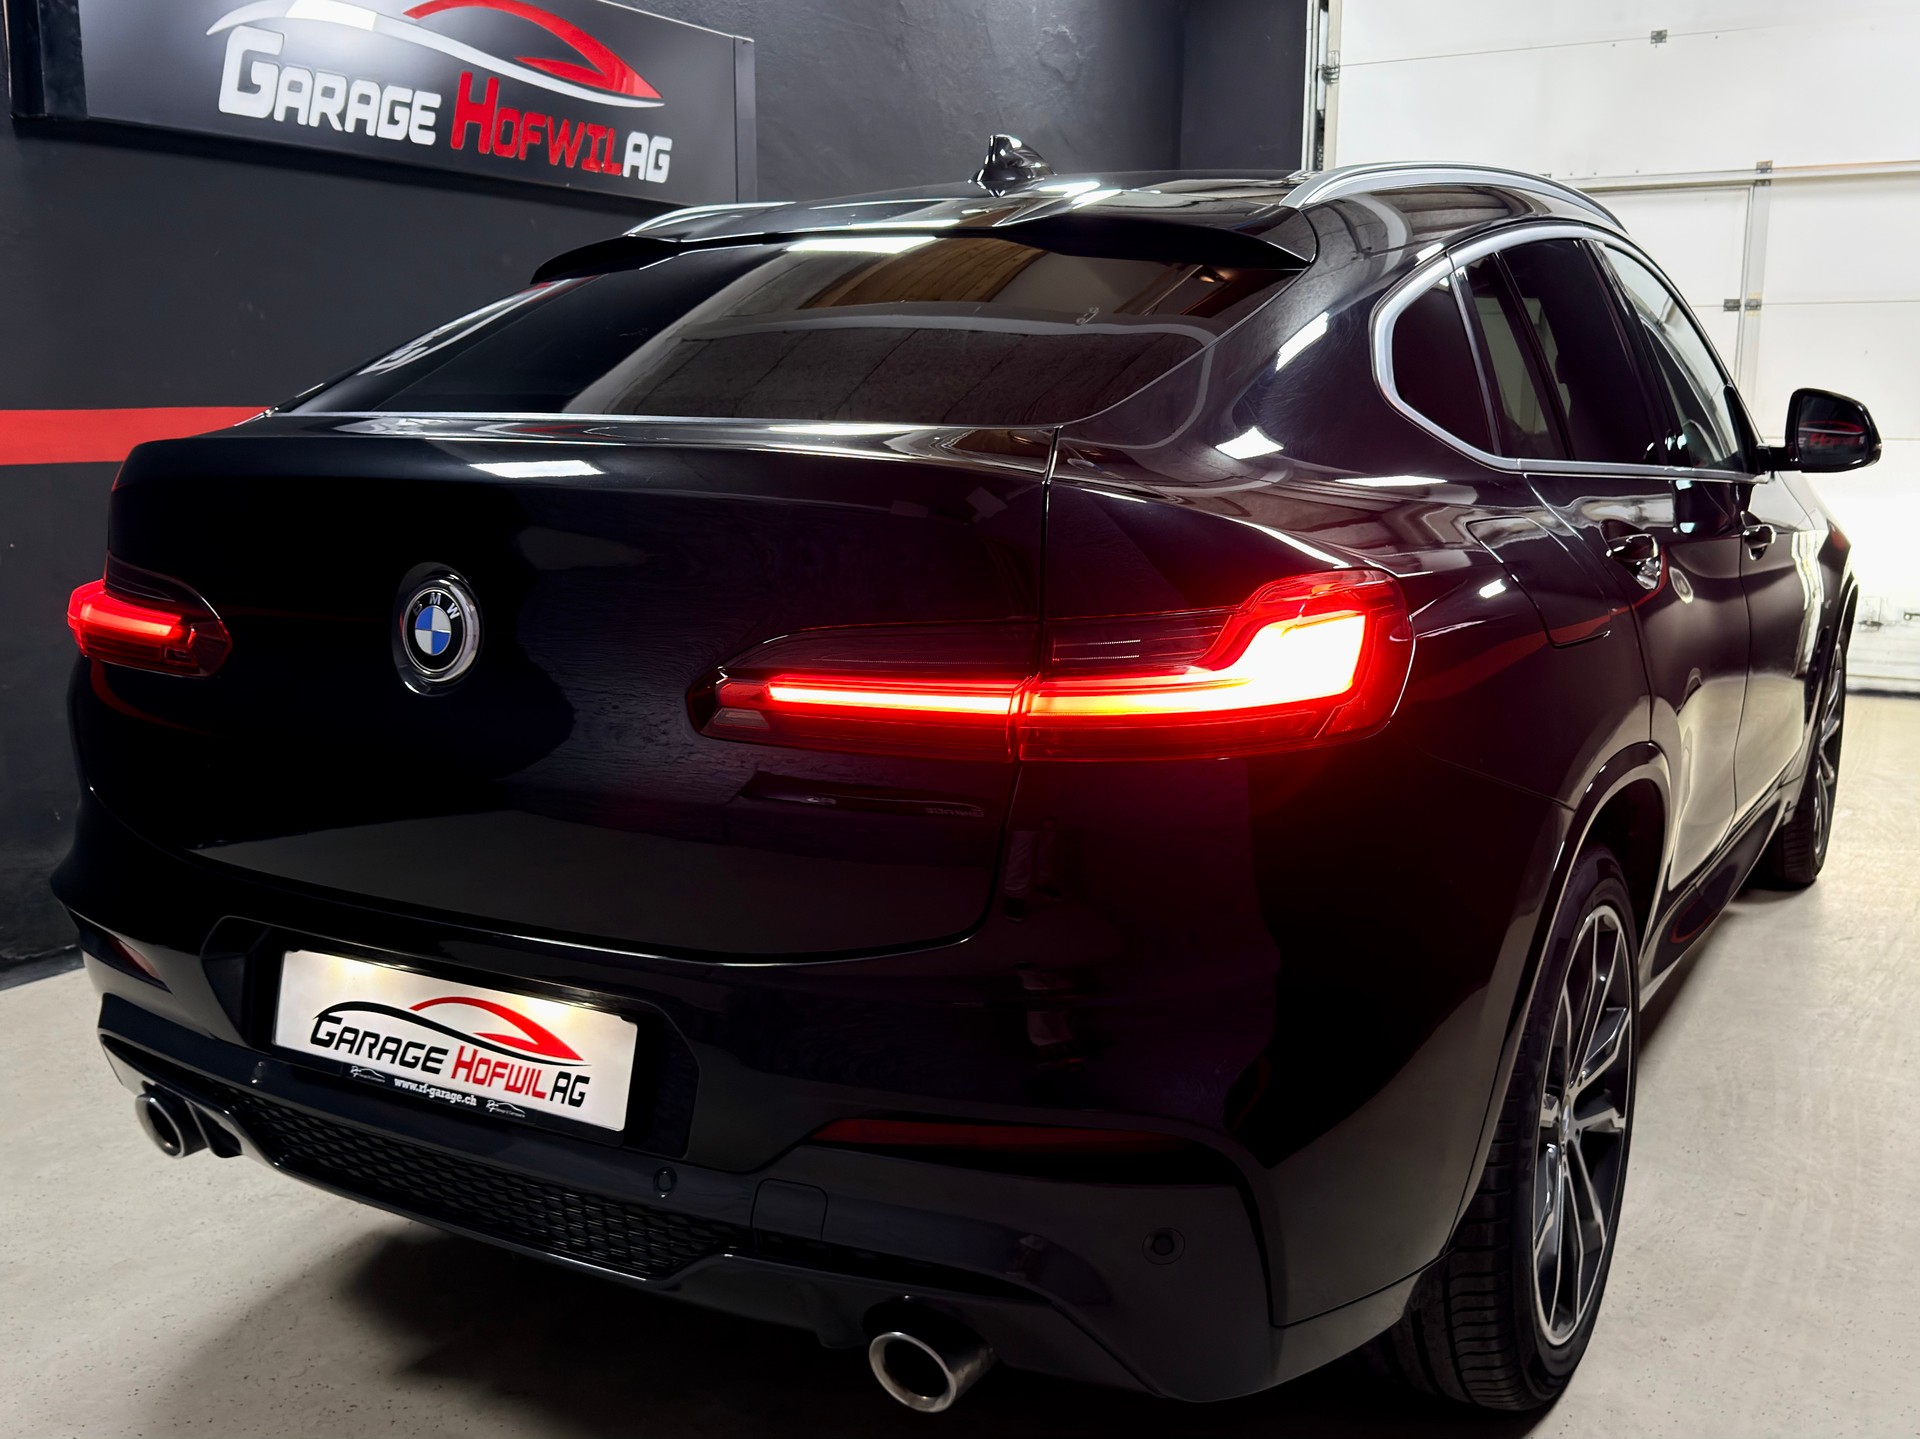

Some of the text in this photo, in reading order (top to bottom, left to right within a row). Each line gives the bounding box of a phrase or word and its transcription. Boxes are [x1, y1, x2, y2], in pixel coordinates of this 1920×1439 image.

[218, 25, 442, 146] GARAGE
[412, 592, 460, 620] BMW
[310, 1015, 591, 1108] GARAGE HOFWIL AG
[394, 1078, 477, 1106] www.rf-garage.ch
